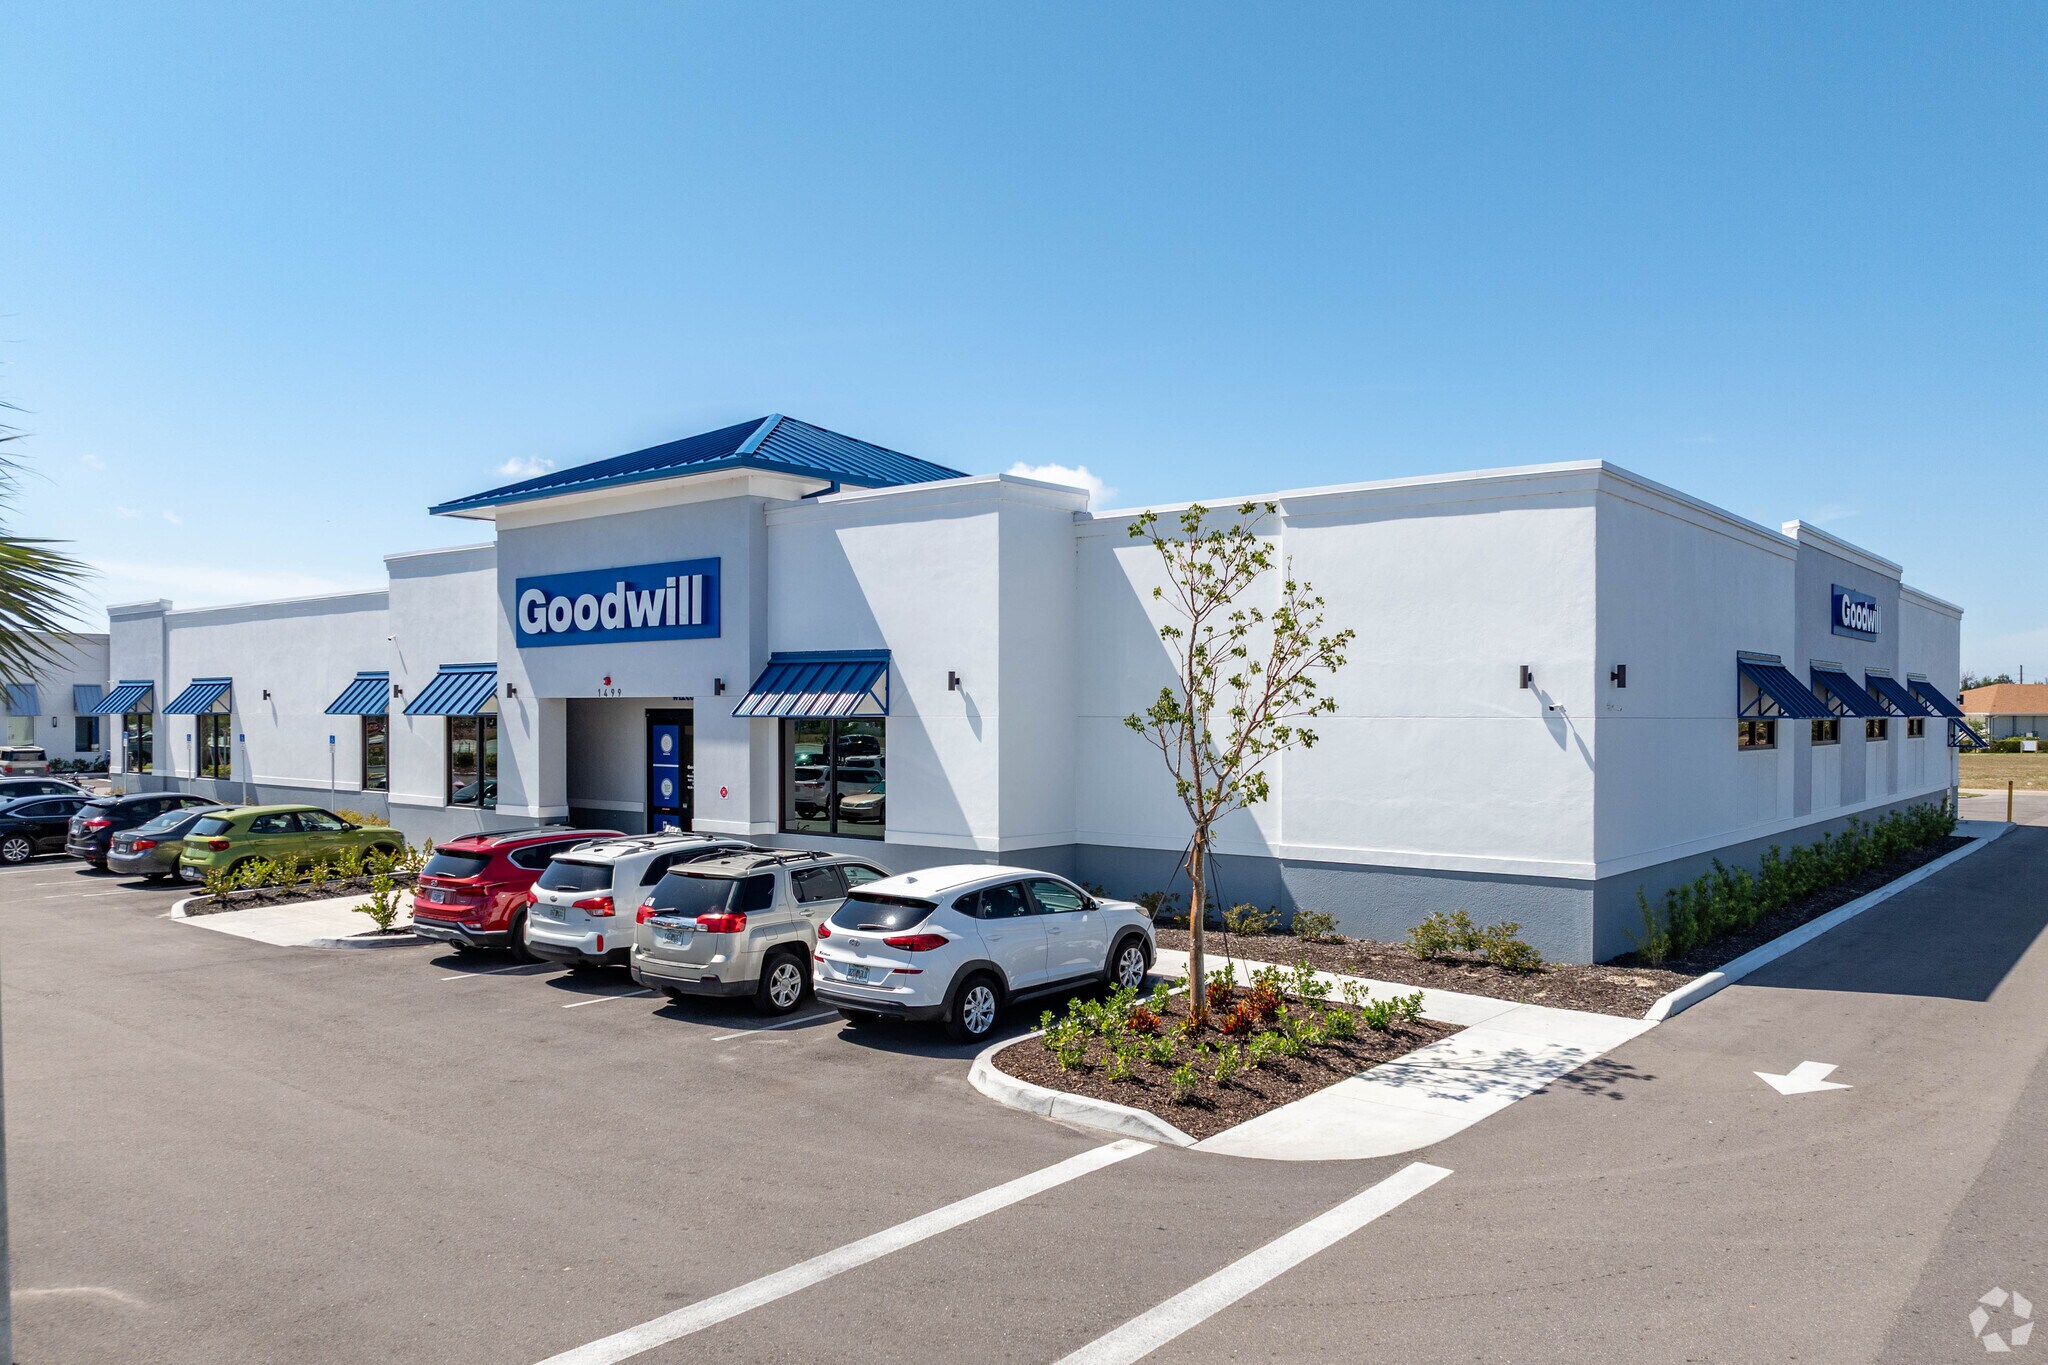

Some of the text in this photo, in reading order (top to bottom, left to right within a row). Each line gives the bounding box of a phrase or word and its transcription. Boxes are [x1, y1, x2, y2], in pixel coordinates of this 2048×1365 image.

[518, 574, 703, 635] Goodwill
[1841, 593, 1882, 634] Goodwill
[597, 688, 622, 698] 1499
